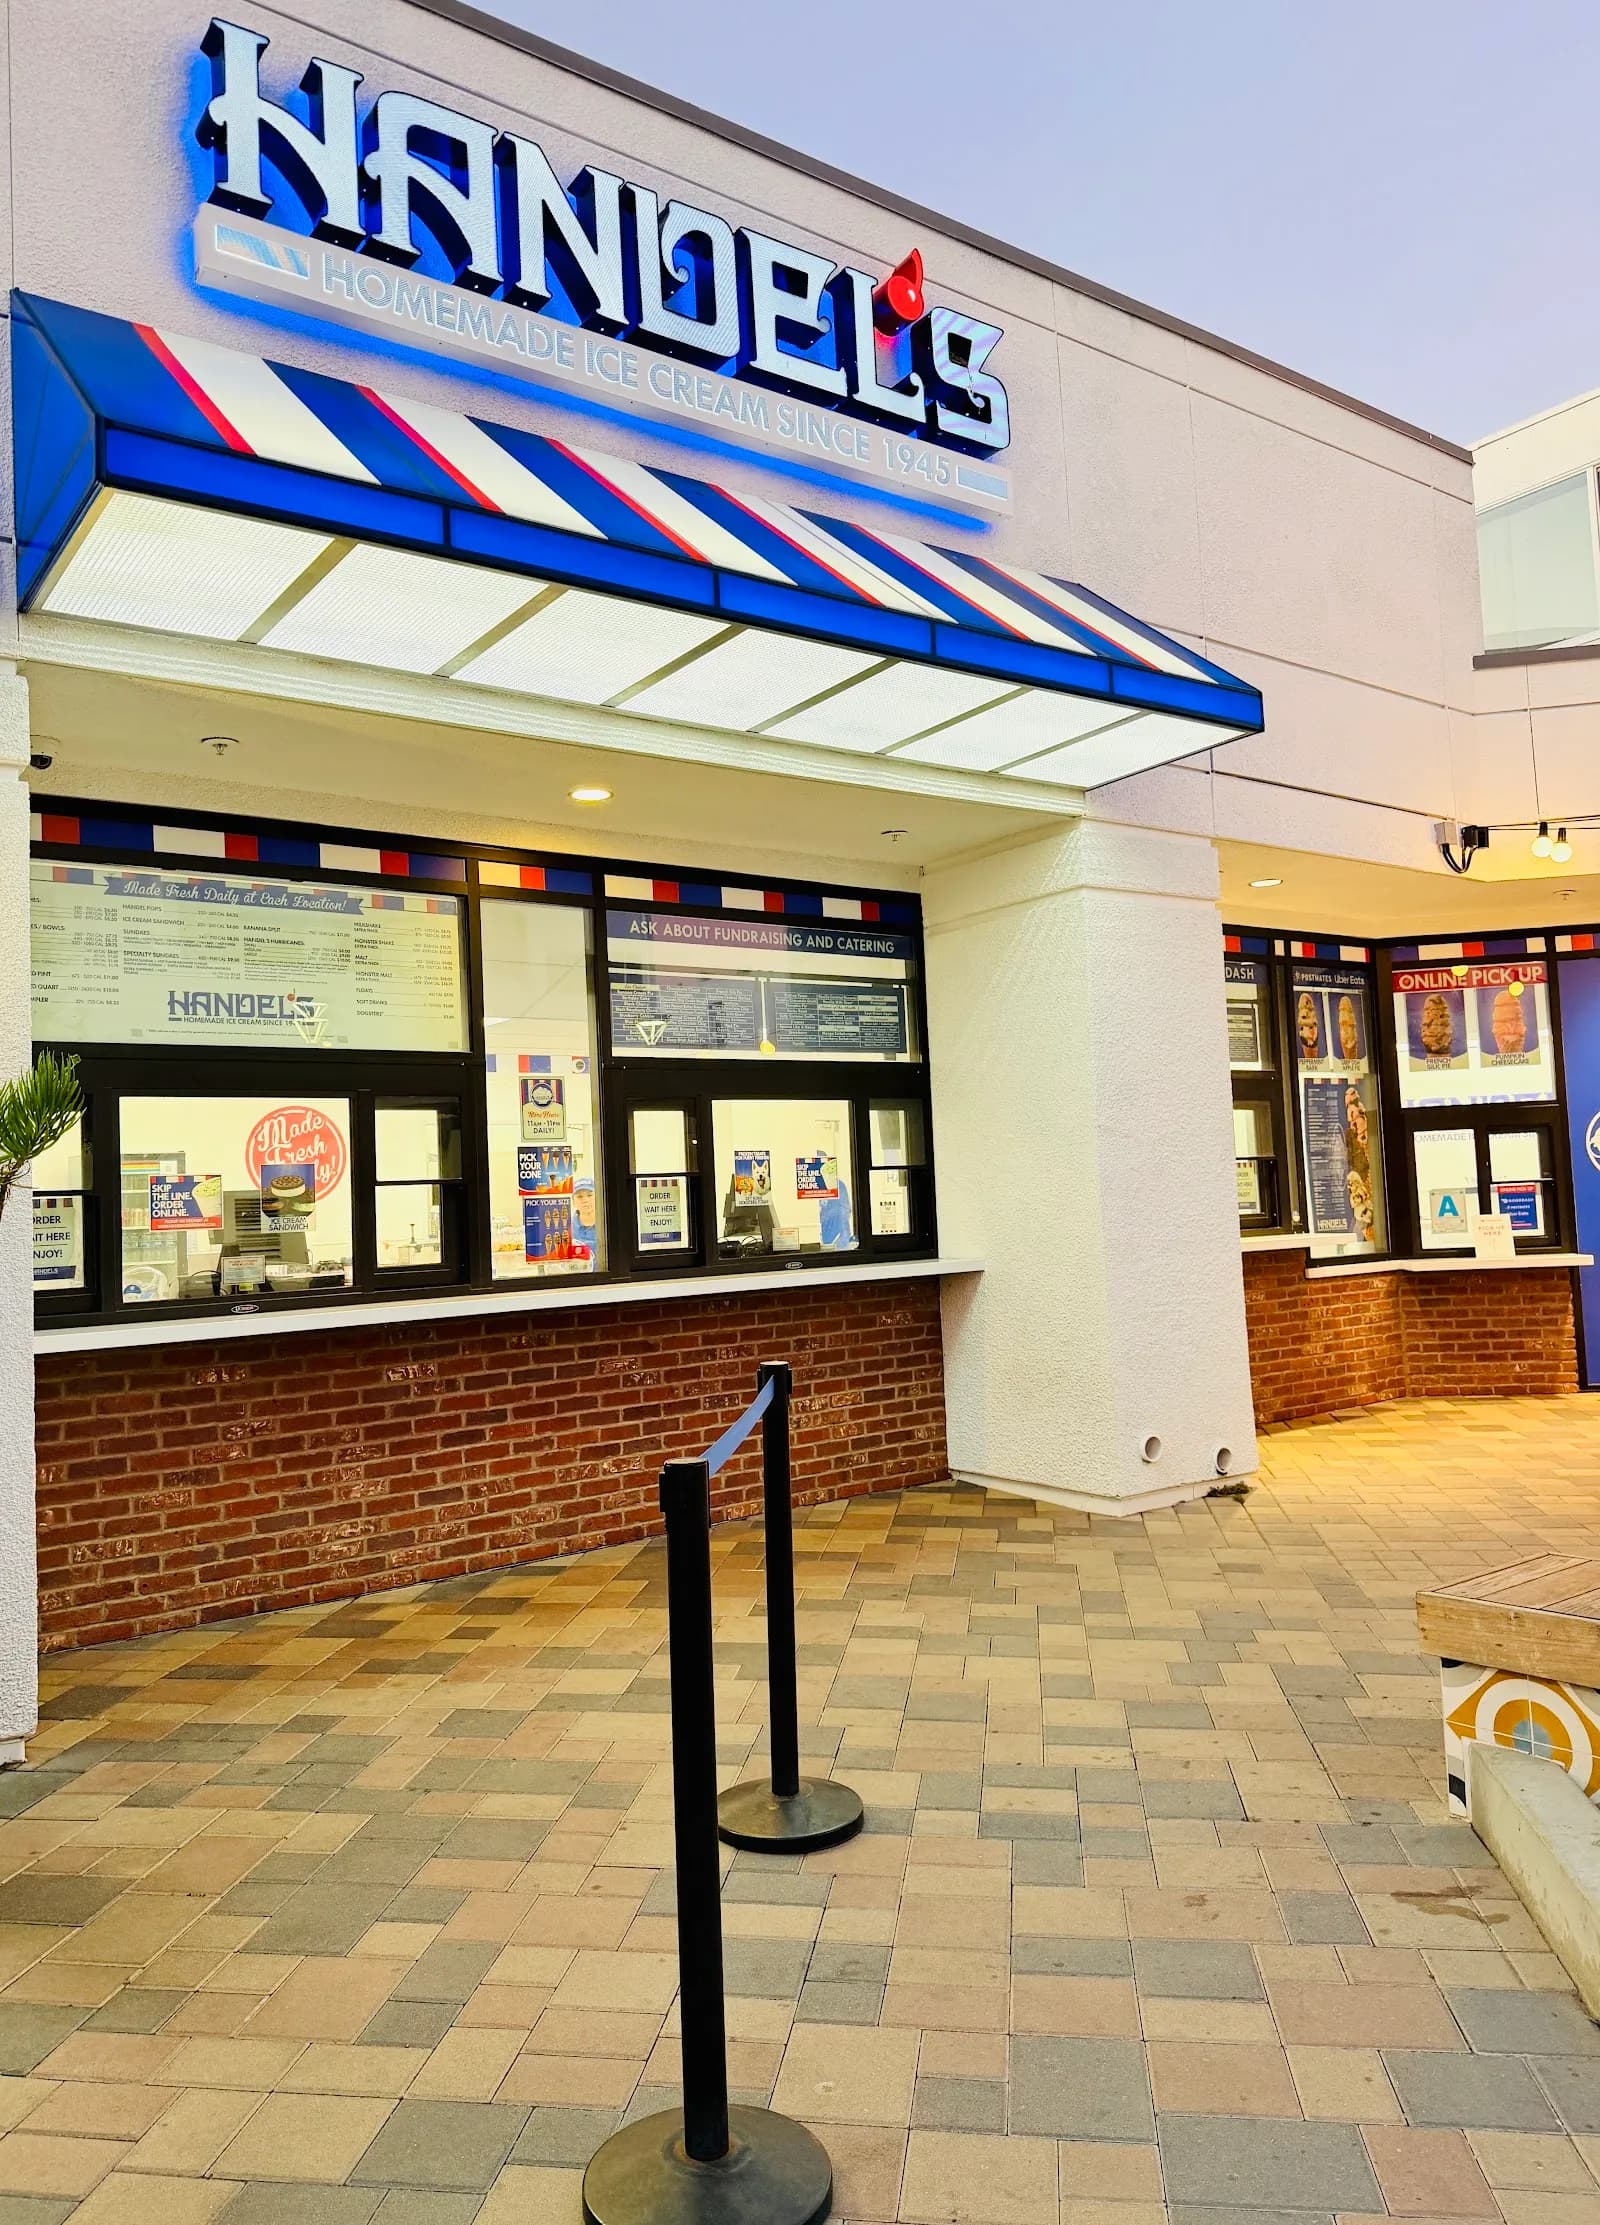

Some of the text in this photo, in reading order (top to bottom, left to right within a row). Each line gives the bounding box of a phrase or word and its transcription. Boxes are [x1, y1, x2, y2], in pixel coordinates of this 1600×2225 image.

[196, 17, 1012, 452] HANDEL'S
[321, 251, 952, 486] HOMEMADE ICE CREAM SINCE 1945
[123, 880, 347, 912] Made Fresh Daily at Each Location!
[122, 928, 151, 936] SUNDAES
[629, 919, 895, 955] ASK ABOUT FUNDRAISING AND CATERING
[123, 950, 152, 958] SPECIALTY
[1225, 967, 1255, 980] DASH
[1398, 966, 1544, 990] ONLINE PICK UP
[1301, 973, 1366, 985] POSTMATES Uber Eats
[168, 988, 316, 1020] HANDEL'S
[183, 1016, 225, 1024] HOMEMADE
[237, 1018, 263, 1026] CREAM
[257, 1110, 326, 1152] Made
[1414, 1133, 1470, 1144] OMEMADE
[264, 1134, 328, 1165] Fresh
[519, 1153, 537, 1162] PICK
[314, 1155, 337, 1183] ly!
[519, 1161, 541, 1170] YOUR
[519, 1170, 542, 1179] CONE
[152, 1184, 172, 1193] SKIP
[152, 1191, 193, 1201] THE LINE.
[649, 1192, 671, 1200] ORDER
[152, 1200, 184, 1210] ORDER
[644, 1205, 678, 1213] WAIT HERE
[1438, 1195, 1460, 1217] A
[152, 1208, 190, 1218] ONLINE.
[271, 1216, 308, 1225] ICE CREAM
[650, 1219, 673, 1227] ENJOY!
[268, 1223, 309, 1231] SANDWICH
[46, 1231, 71, 1241] HERE
[33, 1249, 63, 1259] NJOY!
